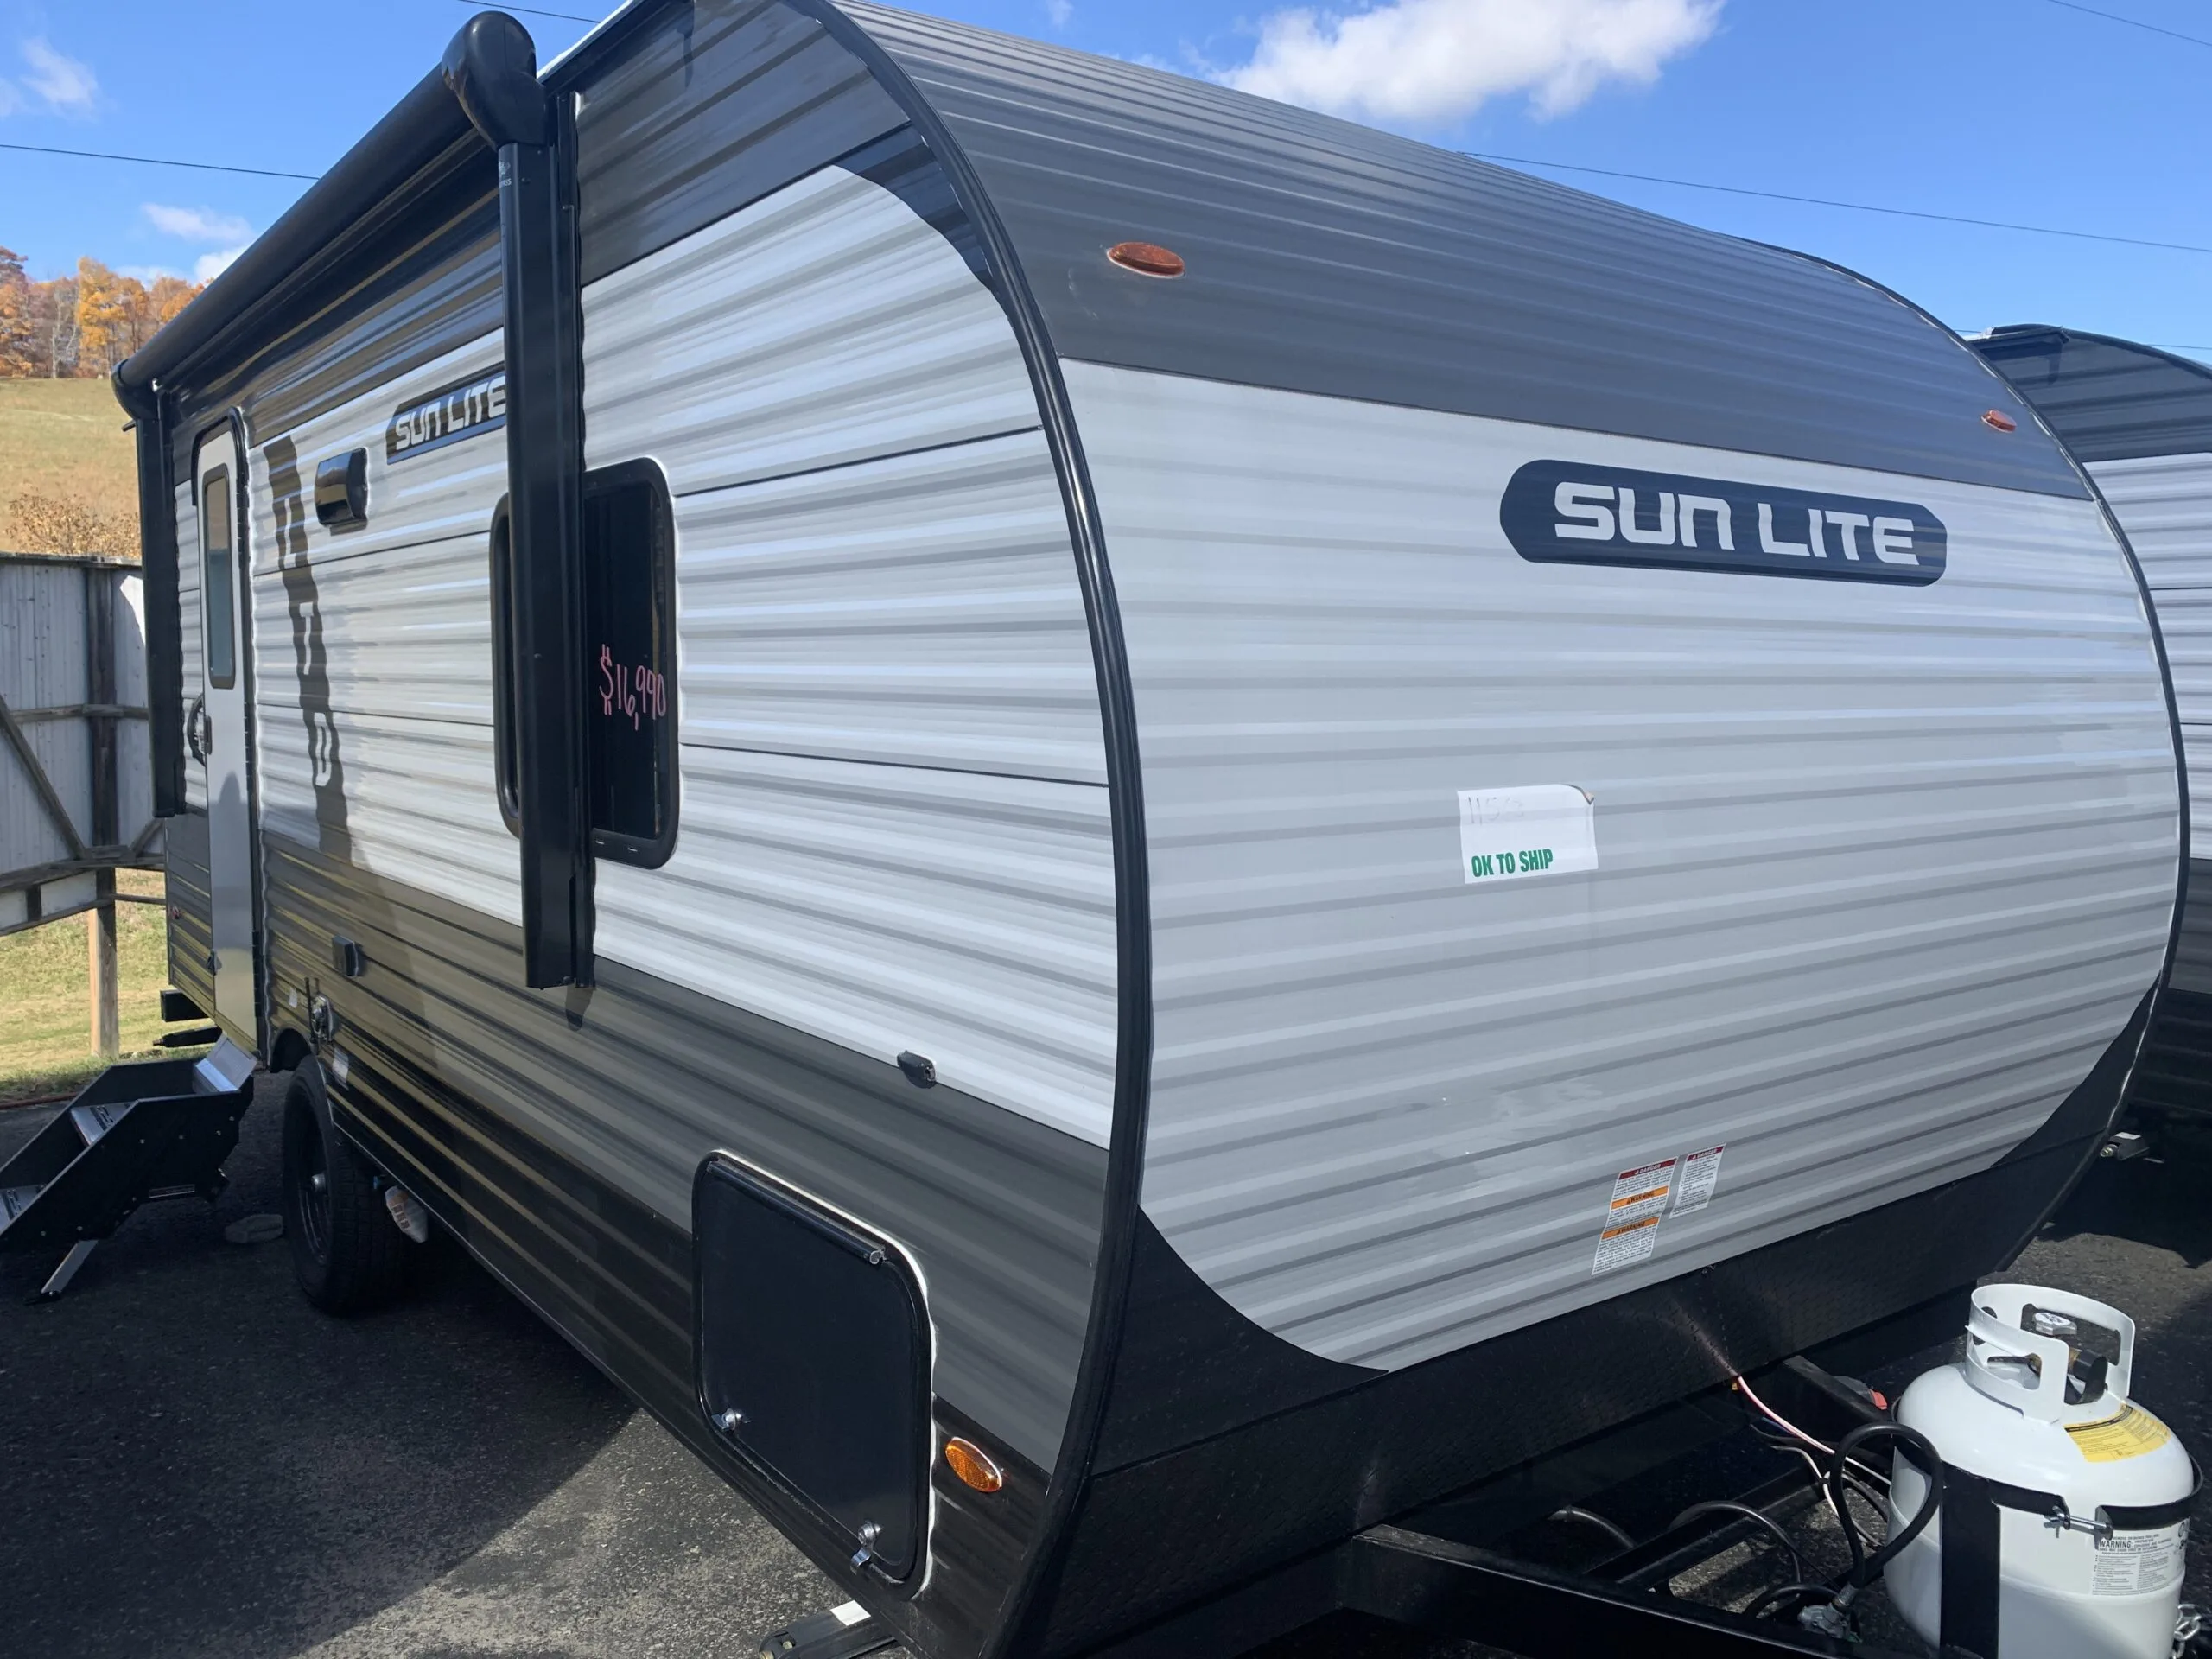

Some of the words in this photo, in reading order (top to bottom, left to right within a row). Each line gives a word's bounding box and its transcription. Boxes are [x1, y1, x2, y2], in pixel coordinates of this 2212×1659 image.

[395, 400, 441, 451] SUN
[448, 375, 506, 433] LITE
[1554, 480, 1735, 550] SUN
[1758, 503, 1920, 566] LITE
[599, 644, 667, 731] $16,990
[1471, 854, 1495, 877] OK
[1496, 852, 1516, 874] TO
[1519, 849, 1554, 873] SHIP
[1639, 1163, 1662, 1174] DANGER
